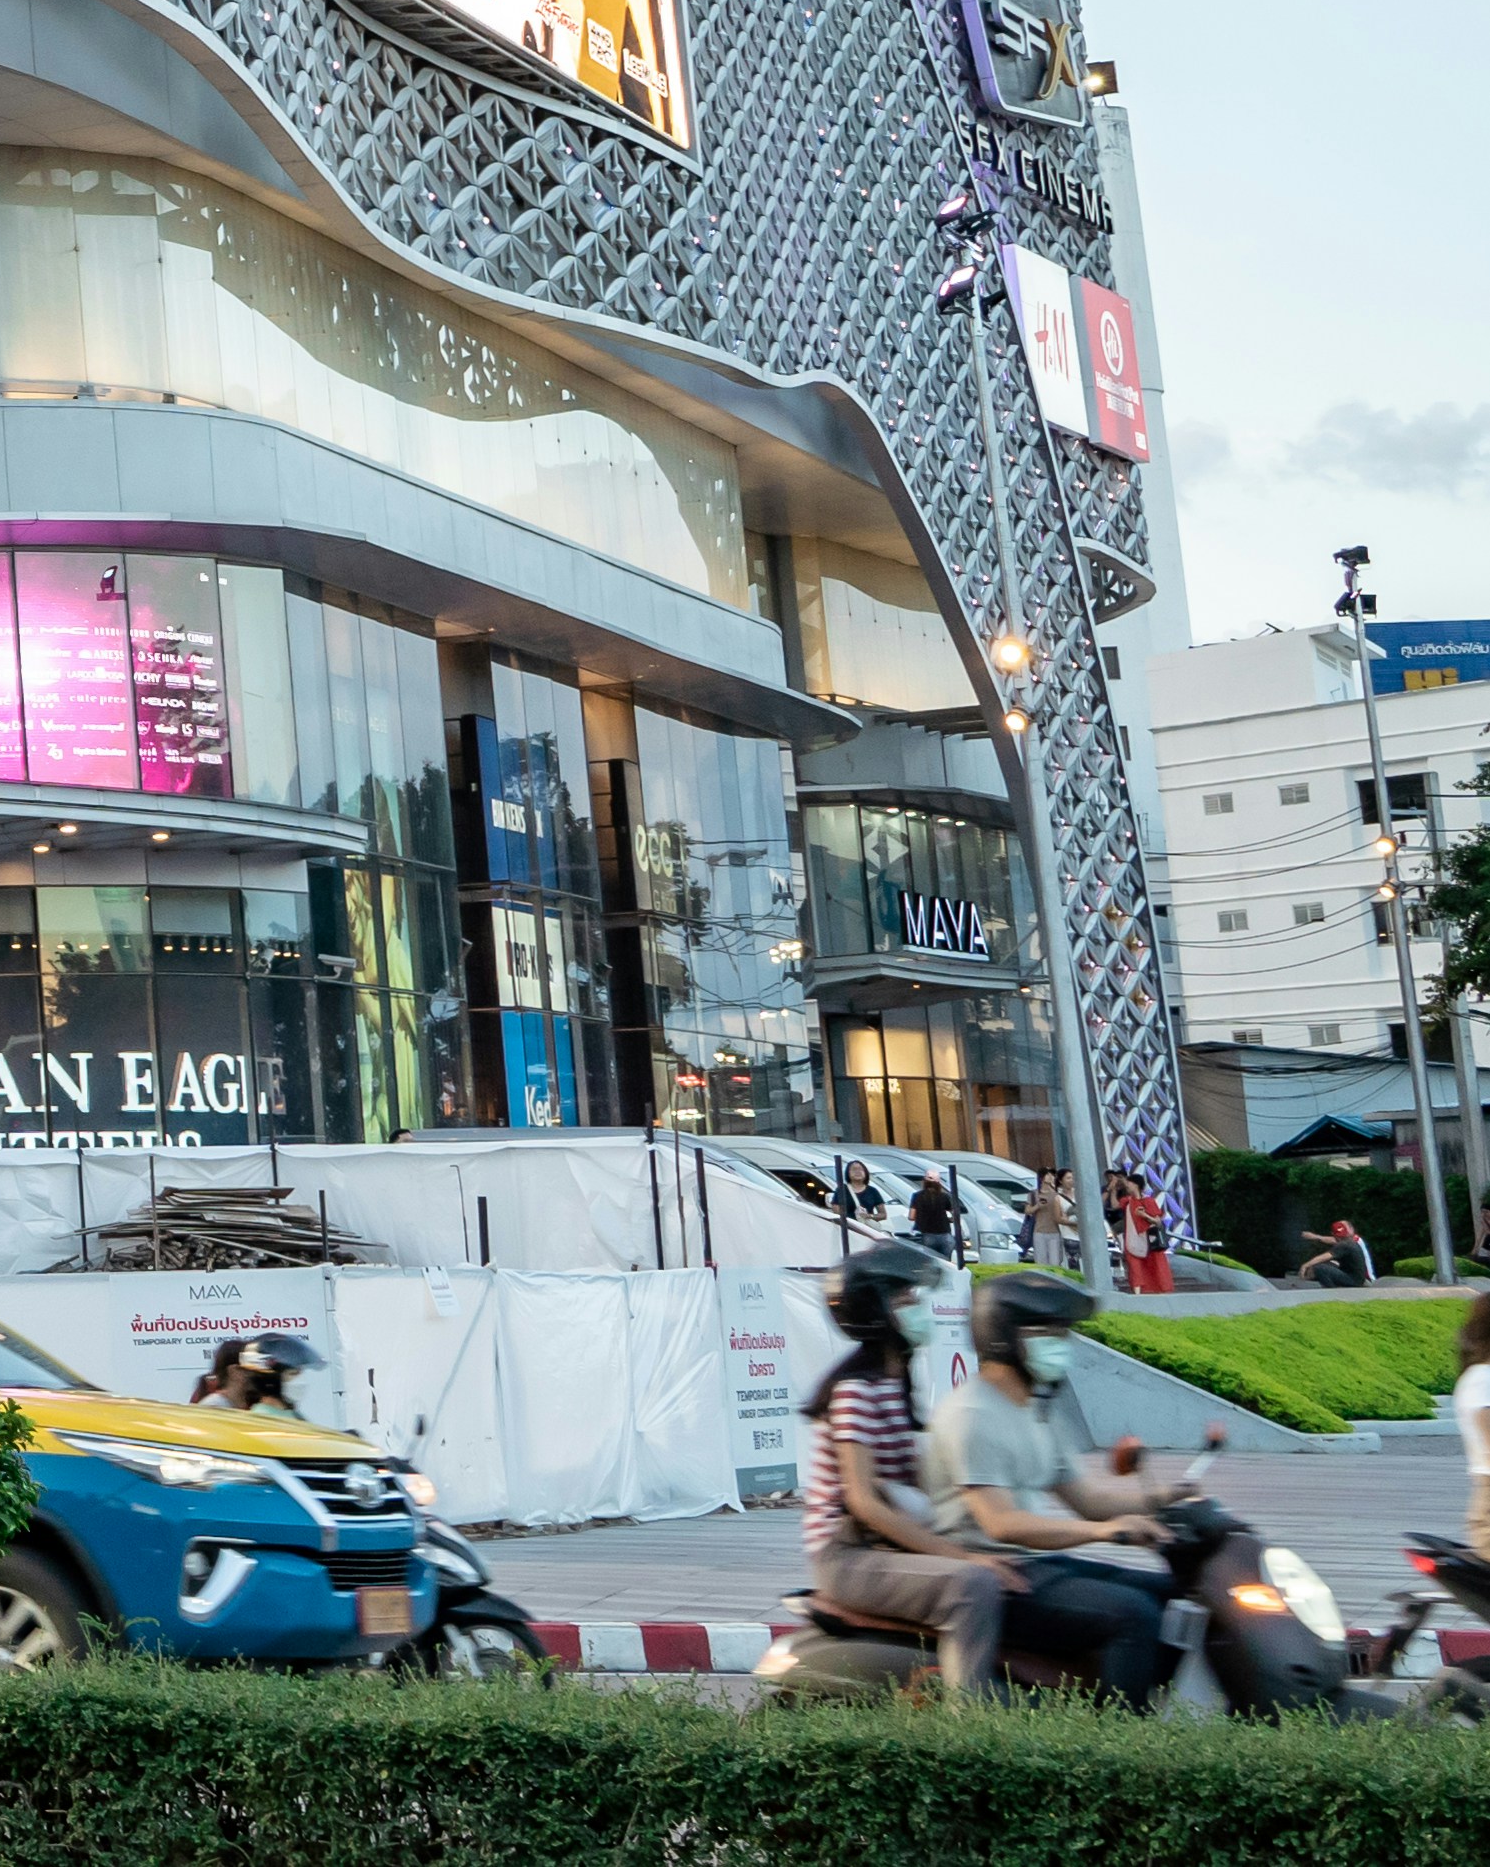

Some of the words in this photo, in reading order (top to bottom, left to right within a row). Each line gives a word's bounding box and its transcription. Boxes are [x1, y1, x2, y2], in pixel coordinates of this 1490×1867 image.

[957, 113, 1011, 176] SFX
[1014, 147, 1115, 235] CINEMA
[69, 694, 97, 703] cute
[898, 890, 989, 954] MAYA
[189, 1284, 242, 1300] MAYA
[131, 1311, 308, 1334] พื้นที่ปิดปรับปรุงชั่วคราว
[133, 1338, 182, 1346] TEMPORARY
[185, 1336, 211, 1345] CLOSE
[736, 1389, 771, 1402] TEMPORARY
